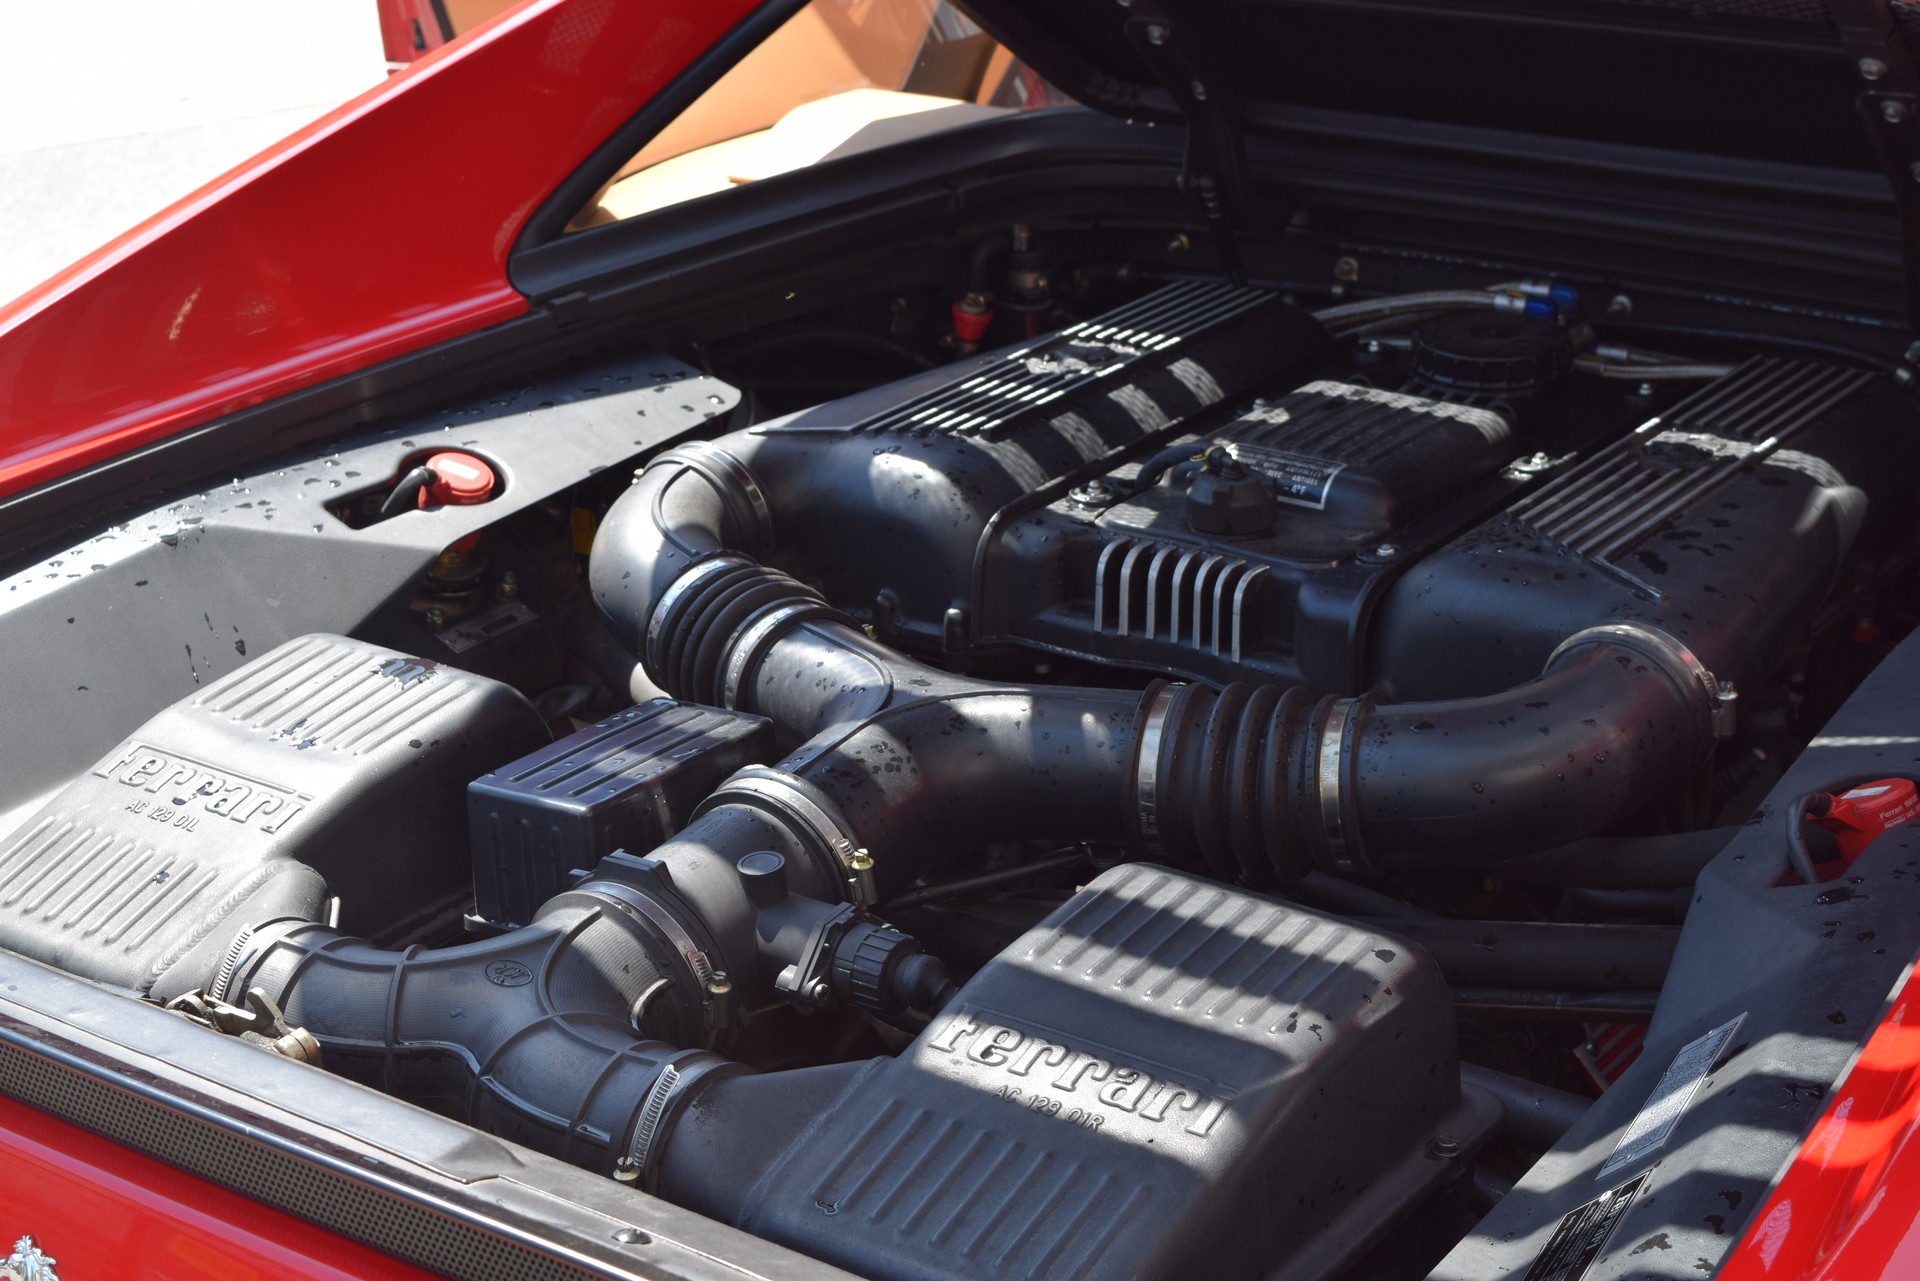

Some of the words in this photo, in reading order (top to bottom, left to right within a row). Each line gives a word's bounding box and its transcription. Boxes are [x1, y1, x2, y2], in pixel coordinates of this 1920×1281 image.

[92, 740, 315, 835] Ferrari
[125, 799, 149, 814] AC
[147, 806, 175, 823] 129
[928, 1002, 1241, 1138] Ferrari
[992, 1084, 1021, 1104] AC
[1026, 1094, 1063, 1117] 129
